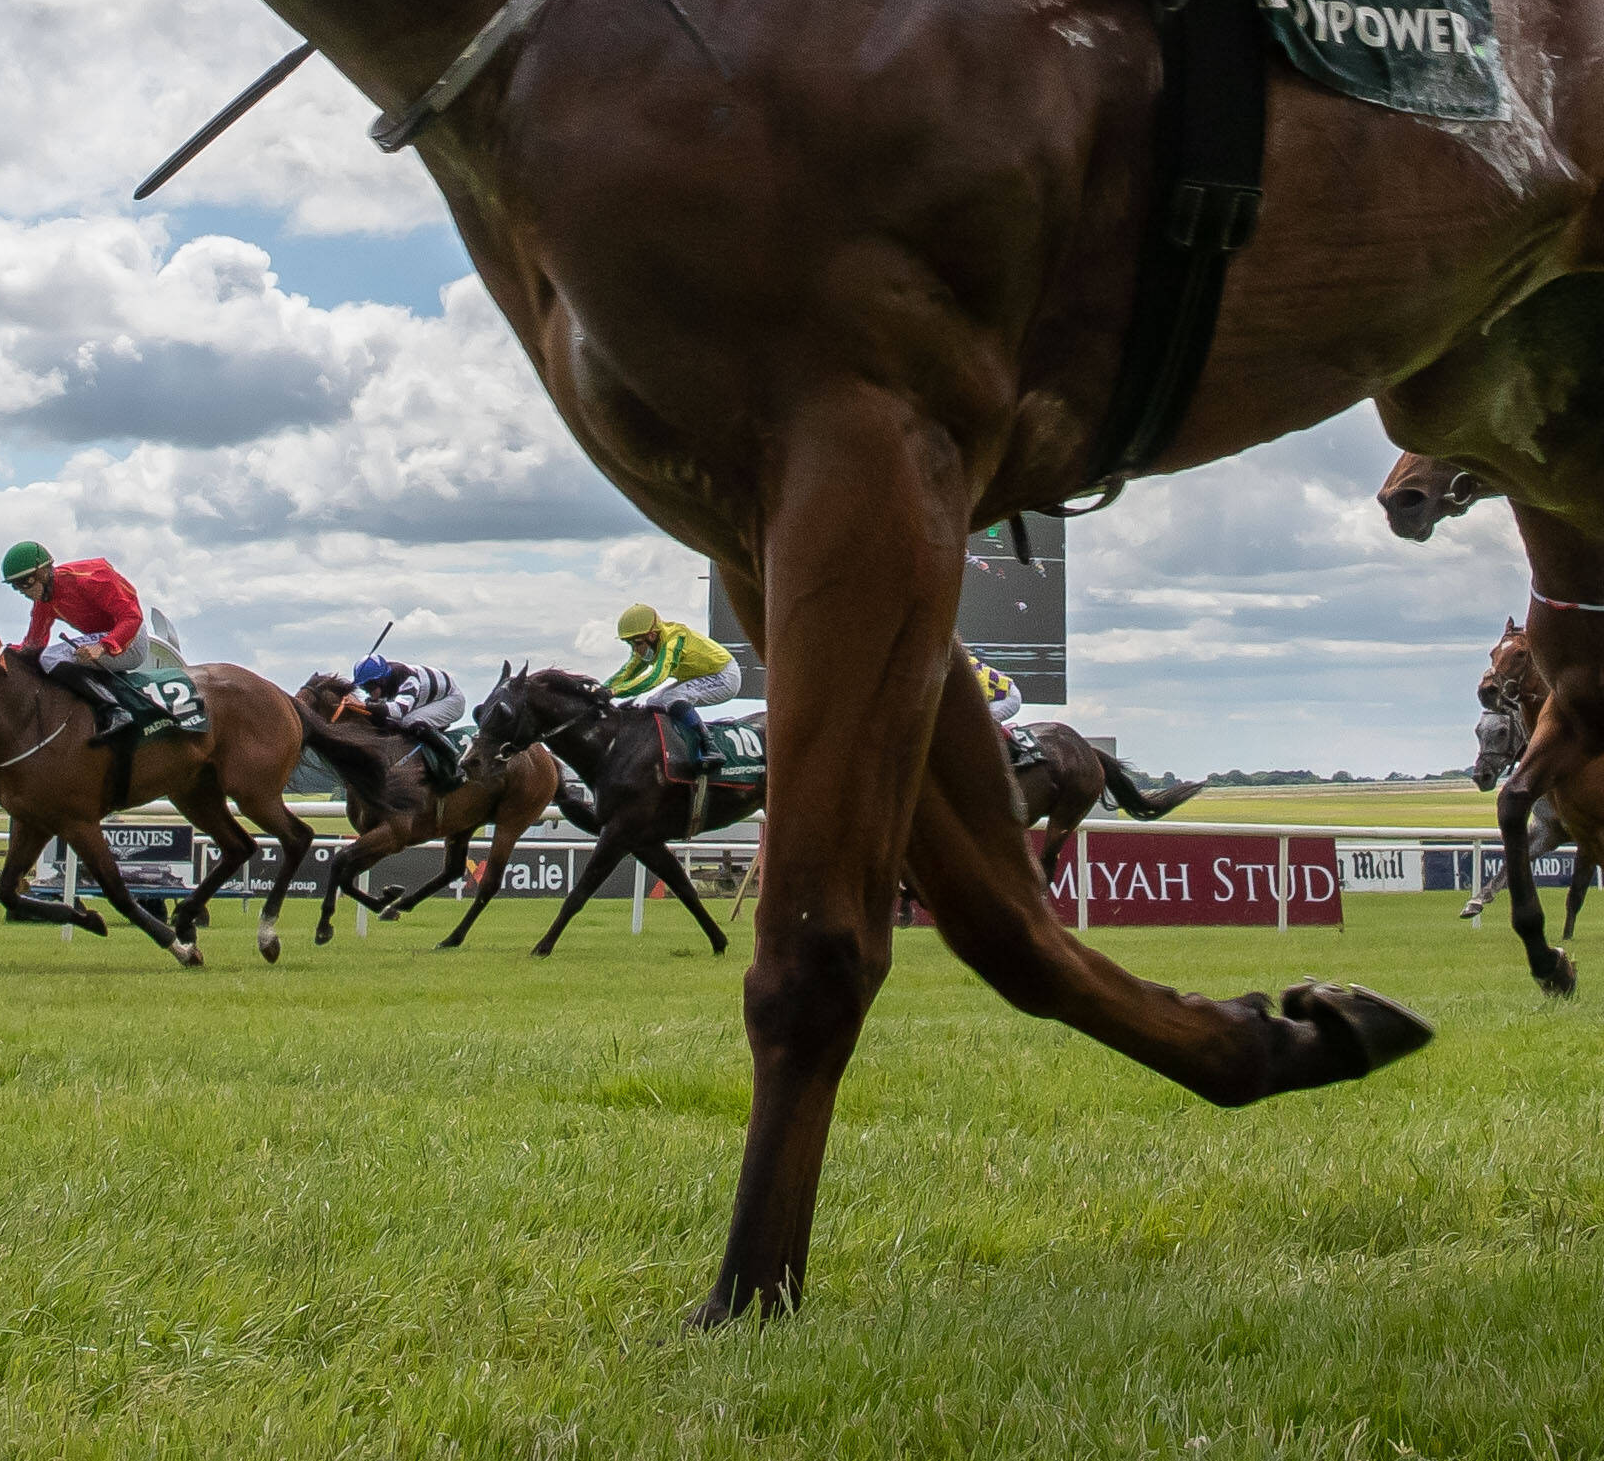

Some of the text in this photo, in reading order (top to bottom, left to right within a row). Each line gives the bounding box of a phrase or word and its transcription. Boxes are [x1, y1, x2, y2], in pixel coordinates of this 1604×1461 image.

[142, 682, 197, 716] 12
[724, 727, 763, 758] 10
[1213, 856, 1335, 903] STUD
